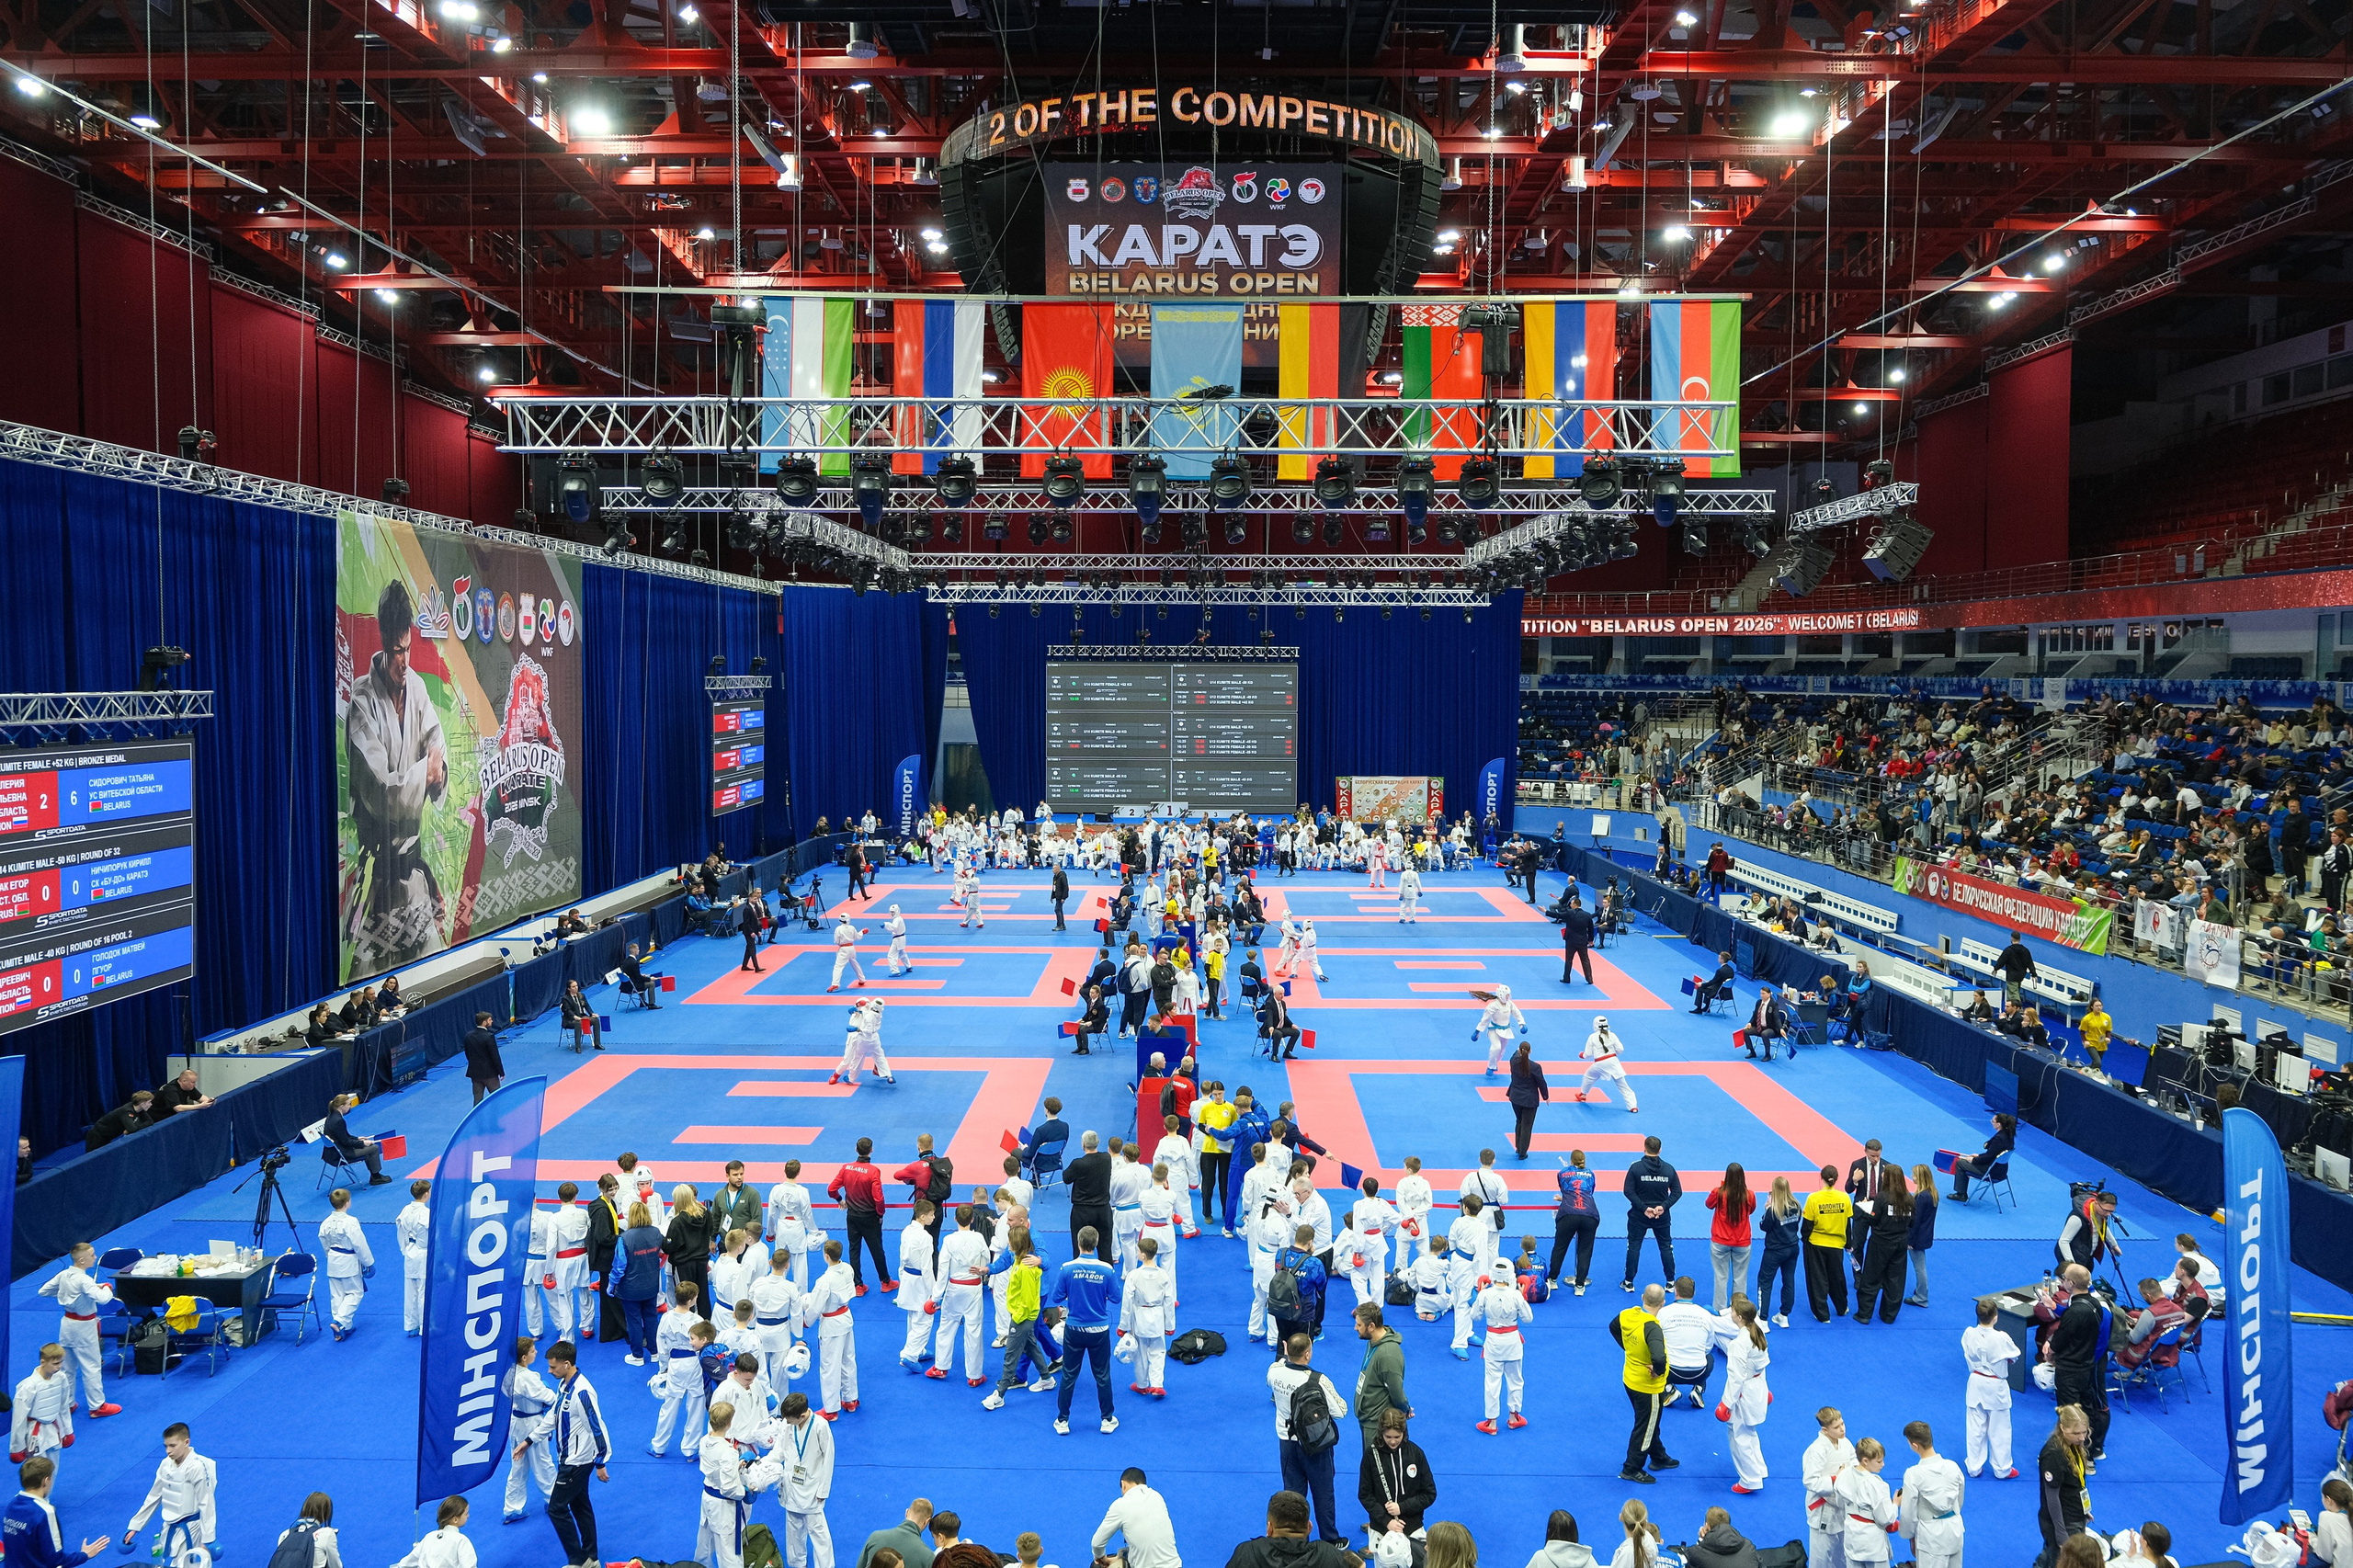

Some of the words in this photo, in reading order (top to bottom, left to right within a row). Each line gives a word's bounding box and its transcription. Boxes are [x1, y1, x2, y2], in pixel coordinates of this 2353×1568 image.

[988, 112, 1007, 147] 2
[1014, 97, 1062, 139] OF
[1072, 88, 1158, 128] THE
[1171, 86, 1421, 160] COMPETITION
[1165, 188, 1201, 200] BELARUS
[1202, 189, 1225, 200] OPEN
[1068, 224, 1324, 269] КАРАТЭ
[1069, 273, 1220, 294] BELARUS
[1229, 273, 1320, 294] OPEN
[1520, 619, 1578, 634] TITION
[1581, 619, 1675, 634] "BELARUS
[1681, 619, 1729, 633] OPEN
[1787, 615, 1855, 631] WELCOME
[541, 647, 554, 657] WKF
[1813, 678, 1825, 687] 103
[0, 761, 23, 772] UMITE
[23, 760, 51, 771] FEMALE
[52, 759, 63, 768] +52
[64, 758, 74, 767] KG
[79, 756, 105, 766] BRONZE
[105, 754, 127, 764] MEDAL
[481, 744, 528, 793] BELARUS
[530, 744, 564, 783] OPEN
[89, 776, 128, 788] СИДОРОВИЧ
[128, 773, 155, 784] ТАТЬЯНА
[501, 774, 546, 797] KARATE
[70, 790, 78, 806] 6
[89, 790, 98, 801] УС
[99, 785, 135, 799] ВИТЕБСКОЙ
[136, 784, 163, 794] ОБЛАСТИ
[40, 793, 48, 810] 2
[103, 800, 131, 811] BELARUS
[900, 768, 914, 836] МІНСПОРТ
[1167, 806, 1172, 816] 1
[46, 824, 86, 836] SPORTDATA
[8, 859, 35, 873] KUMITE
[36, 858, 55, 869] MALE
[66, 854, 77, 864] KG
[80, 850, 103, 862] ROUND
[103, 848, 114, 858] OF
[114, 846, 121, 856] 32
[128, 857, 152, 869] КИРИЛЛ
[10, 878, 29, 890] ЕГОР
[91, 878, 100, 888] СК
[126, 870, 149, 881] КАРАТЭ
[42, 885, 50, 902] 0
[72, 880, 79, 895] 0
[105, 885, 133, 898] BELARUS
[49, 907, 88, 920] SPORTDATA
[1953, 881, 2003, 914] БЕЛОРУССКАЯ
[2004, 897, 2054, 930] ФЕДЕРАЦИЯ
[2055, 910, 2087, 939] КАРАТЭ
[24, 952, 44, 964] MALE
[55, 946, 66, 956] KG
[70, 940, 92, 952] ROUND
[93, 937, 103, 947] OF
[103, 935, 111, 944] 16
[111, 932, 128, 942] POOL
[92, 949, 121, 963] ГОЛОДОК
[121, 942, 145, 955] МАТВЕЙ
[43, 976, 51, 993] 0
[74, 969, 81, 984] 0
[105, 970, 133, 984] BELARUS
[49, 995, 89, 1010] SPORTDATA
[845, 1165, 869, 1174] BELARUS
[452, 1150, 512, 1468] МІНСПОРТ
[1273, 1379, 1298, 1392] BELAR
